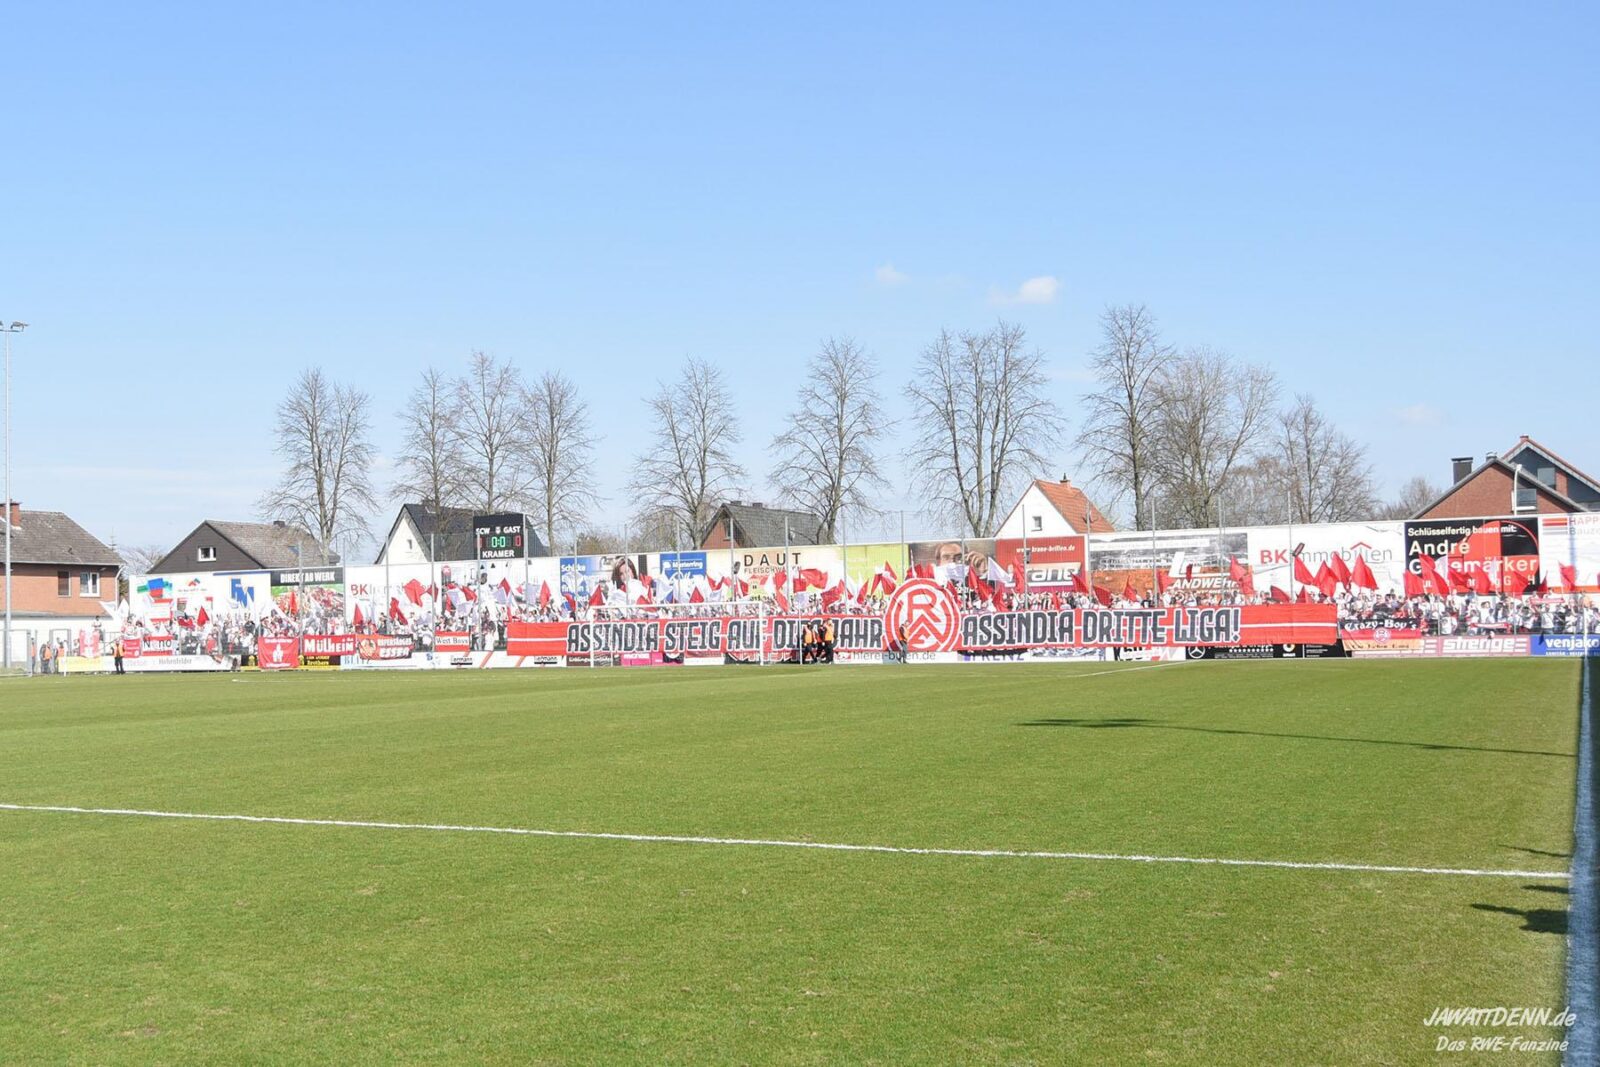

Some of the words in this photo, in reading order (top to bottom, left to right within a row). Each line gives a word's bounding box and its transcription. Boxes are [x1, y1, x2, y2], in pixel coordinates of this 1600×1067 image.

[475, 527, 491, 535] SCW
[503, 525, 521, 533] GAST
[1408, 525, 1471, 537] Schlüsselfertig
[1472, 526, 1499, 534] bauen
[491, 536, 506, 547] 0:0
[1409, 539, 1470, 556] André
[482, 549, 515, 558] KRAMER
[744, 552, 801, 567] DAUT
[963, 610, 1075, 647] ASSINDIA
[1082, 608, 1167, 645] DRITTE
[1174, 606, 1242, 644] LIGA!
[567, 622, 659, 653] ASSINDIA
[664, 620, 721, 651] STEIG
[727, 619, 768, 650] AUF
